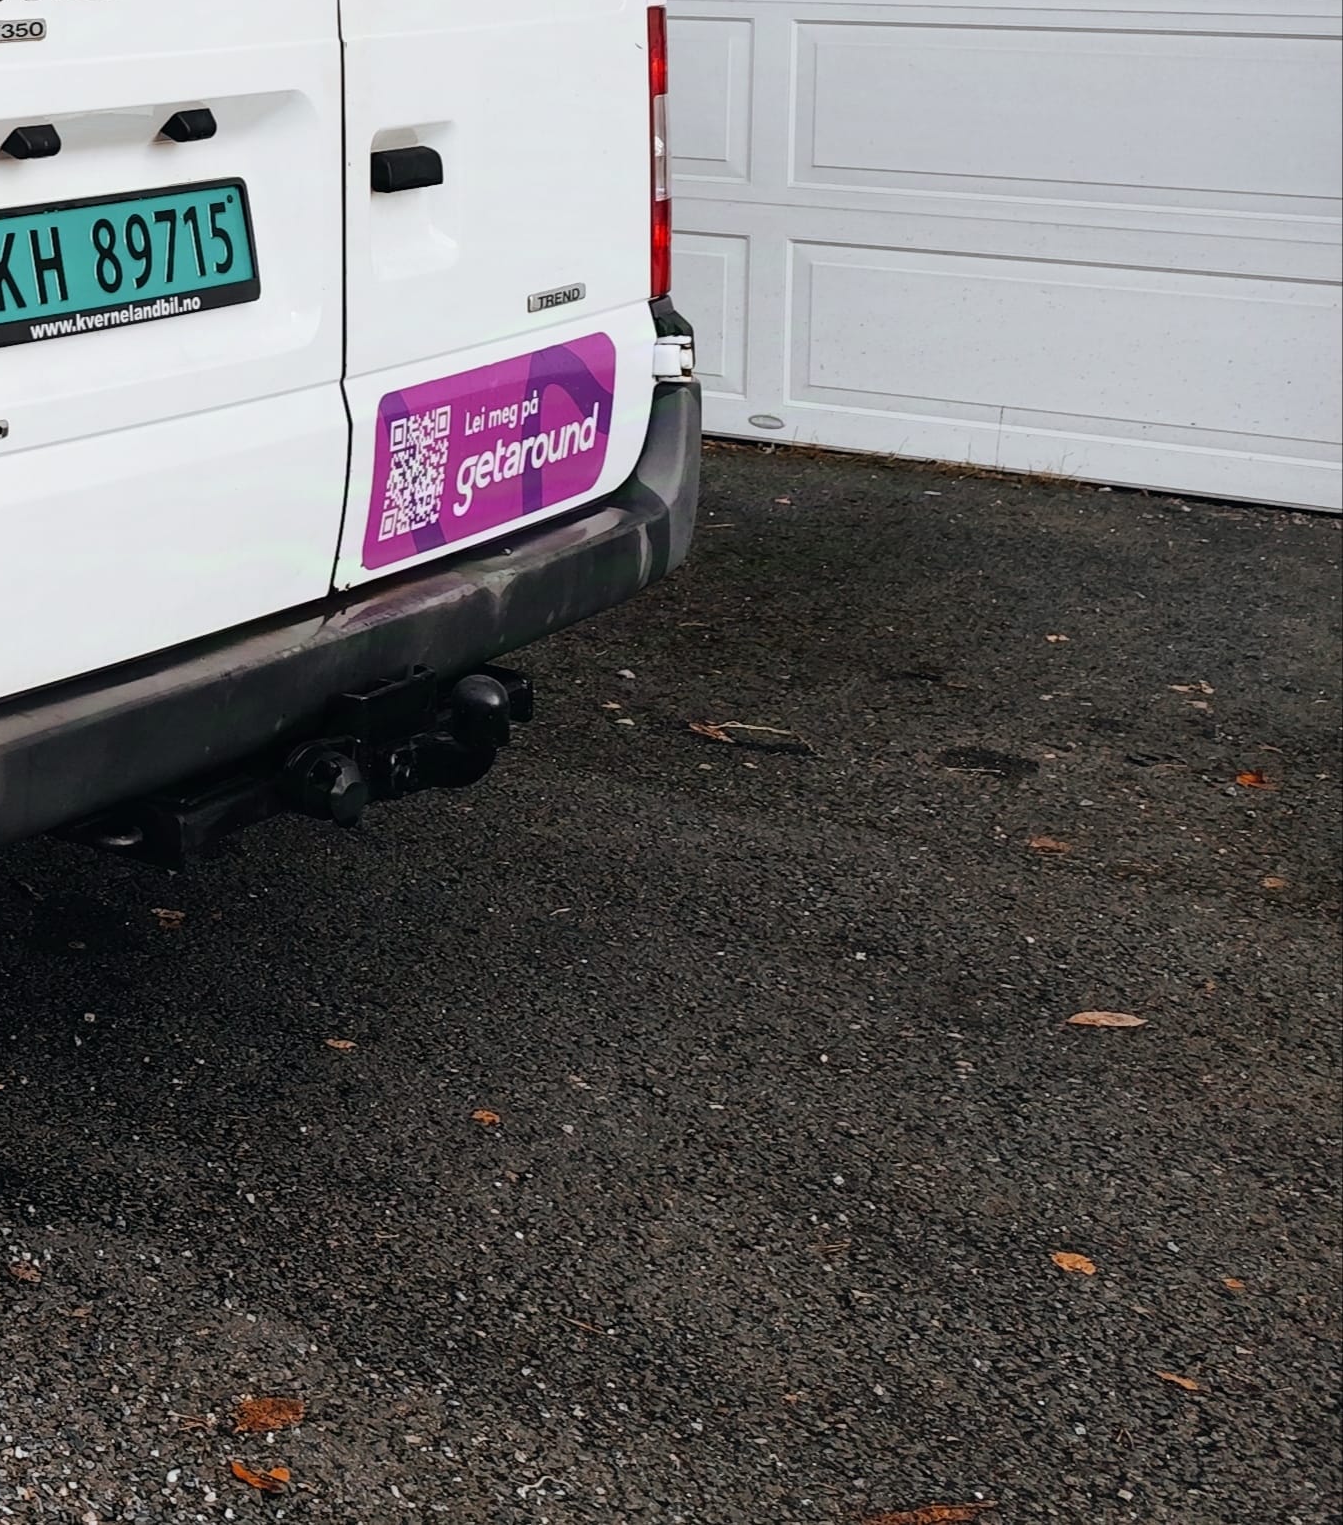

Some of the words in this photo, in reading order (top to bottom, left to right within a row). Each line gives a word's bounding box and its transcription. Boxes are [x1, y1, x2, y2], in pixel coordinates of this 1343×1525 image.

[90, 201, 235, 294] 89715
[30, 295, 202, 340] www.kvernelandbil.no
[537, 287, 581, 310] TREND
[464, 406, 486, 436] Lei
[488, 403, 519, 429] meg
[521, 389, 540, 425] på
[453, 401, 600, 517] getaround
